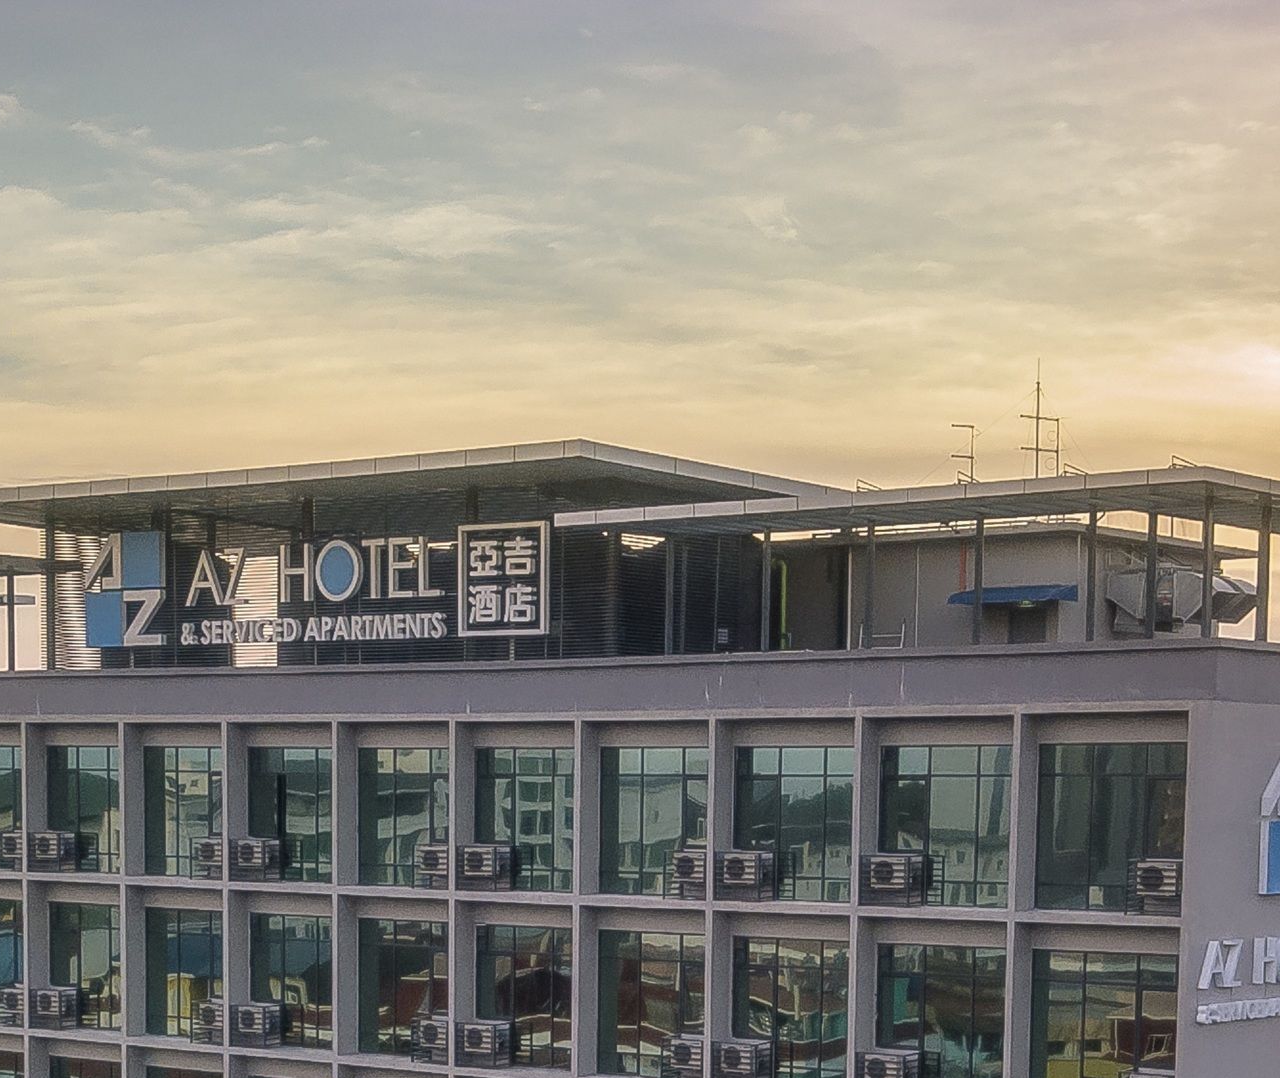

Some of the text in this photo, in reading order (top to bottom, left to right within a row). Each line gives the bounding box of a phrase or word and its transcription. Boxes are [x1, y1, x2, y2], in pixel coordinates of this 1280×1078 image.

[185, 536, 446, 607] AZ HOTEL
[201, 617, 302, 645] SERVICED
[304, 612, 447, 642] APARTMENTS
[1197, 939, 1244, 990] AZ
